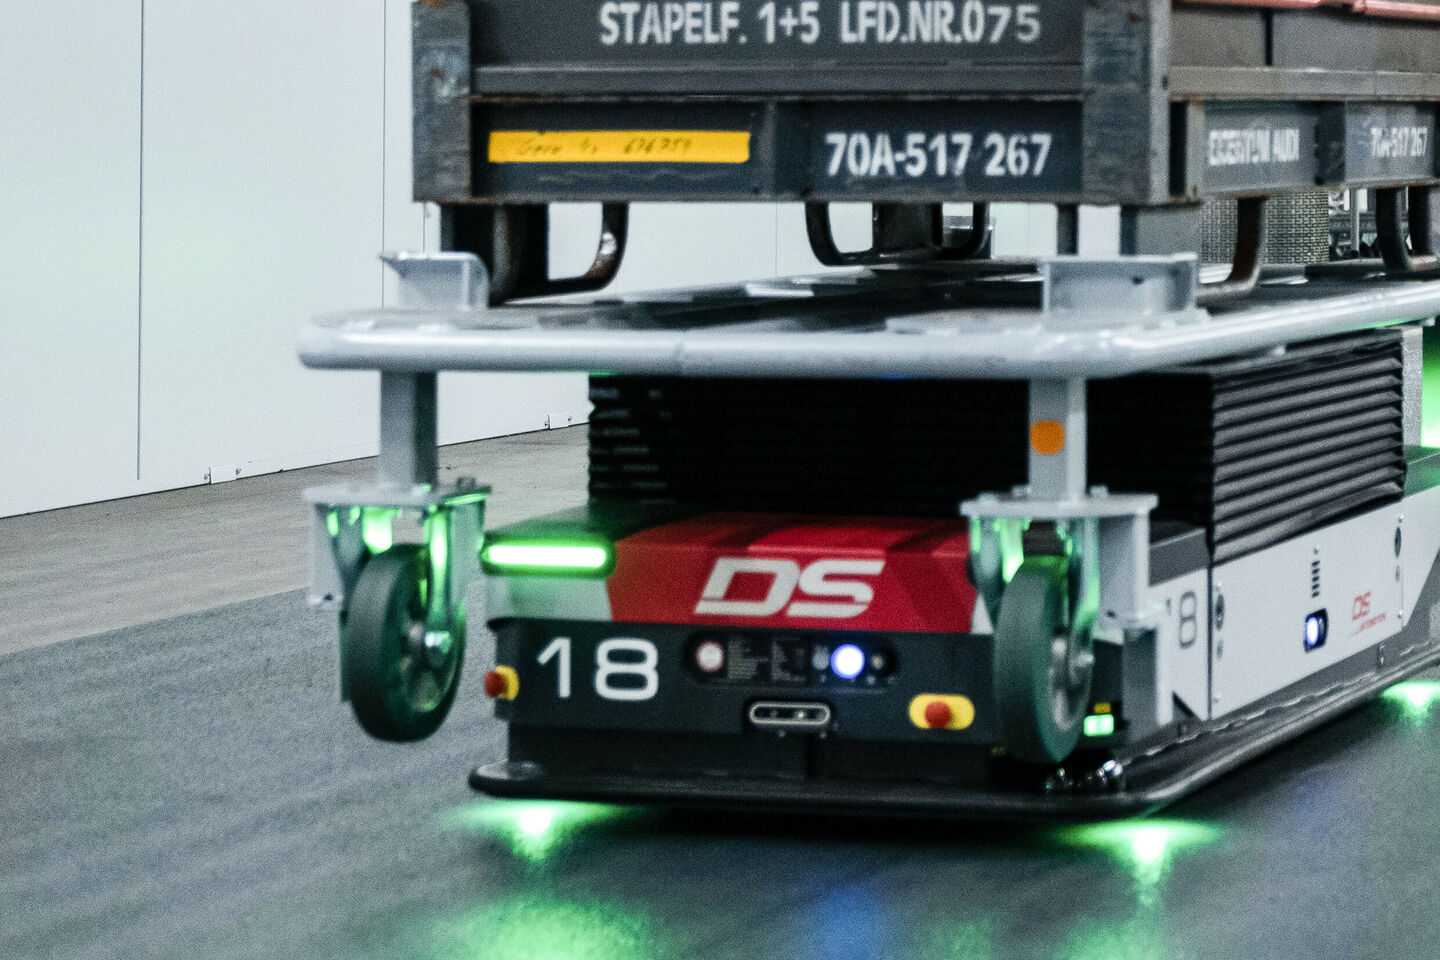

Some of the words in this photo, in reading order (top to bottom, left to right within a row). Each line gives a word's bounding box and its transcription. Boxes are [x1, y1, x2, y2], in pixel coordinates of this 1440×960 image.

[600, 3, 746, 43] STAPELF.
[758, 2, 820, 41] 1+5
[826, 135, 971, 175] 70A-517
[985, 134, 1050, 175] 267
[695, 557, 886, 618] DS
[536, 637, 659, 701] 18
